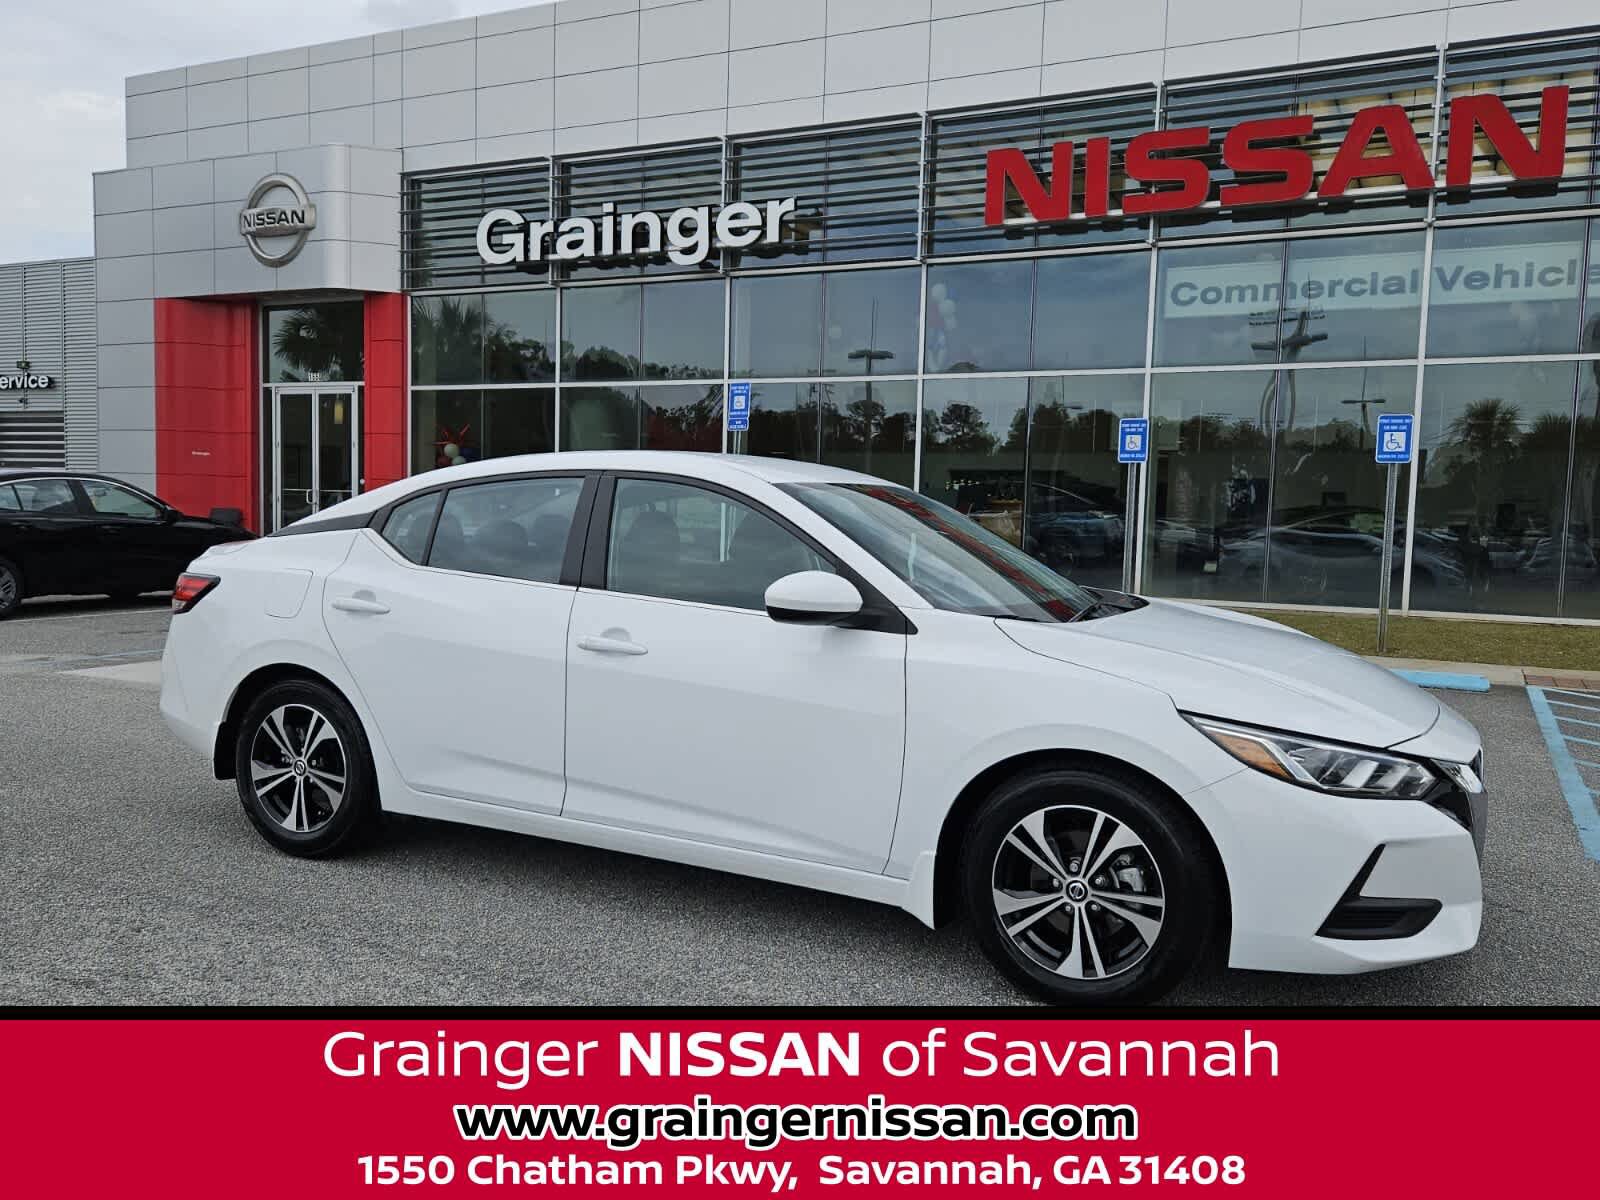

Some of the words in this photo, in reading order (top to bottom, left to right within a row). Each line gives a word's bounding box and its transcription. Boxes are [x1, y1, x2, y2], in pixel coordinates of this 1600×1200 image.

[984, 85, 1569, 225] NISSAN
[243, 209, 305, 229] NISSAN
[476, 197, 796, 266] Grainger
[1170, 268, 1420, 306] Commercial
